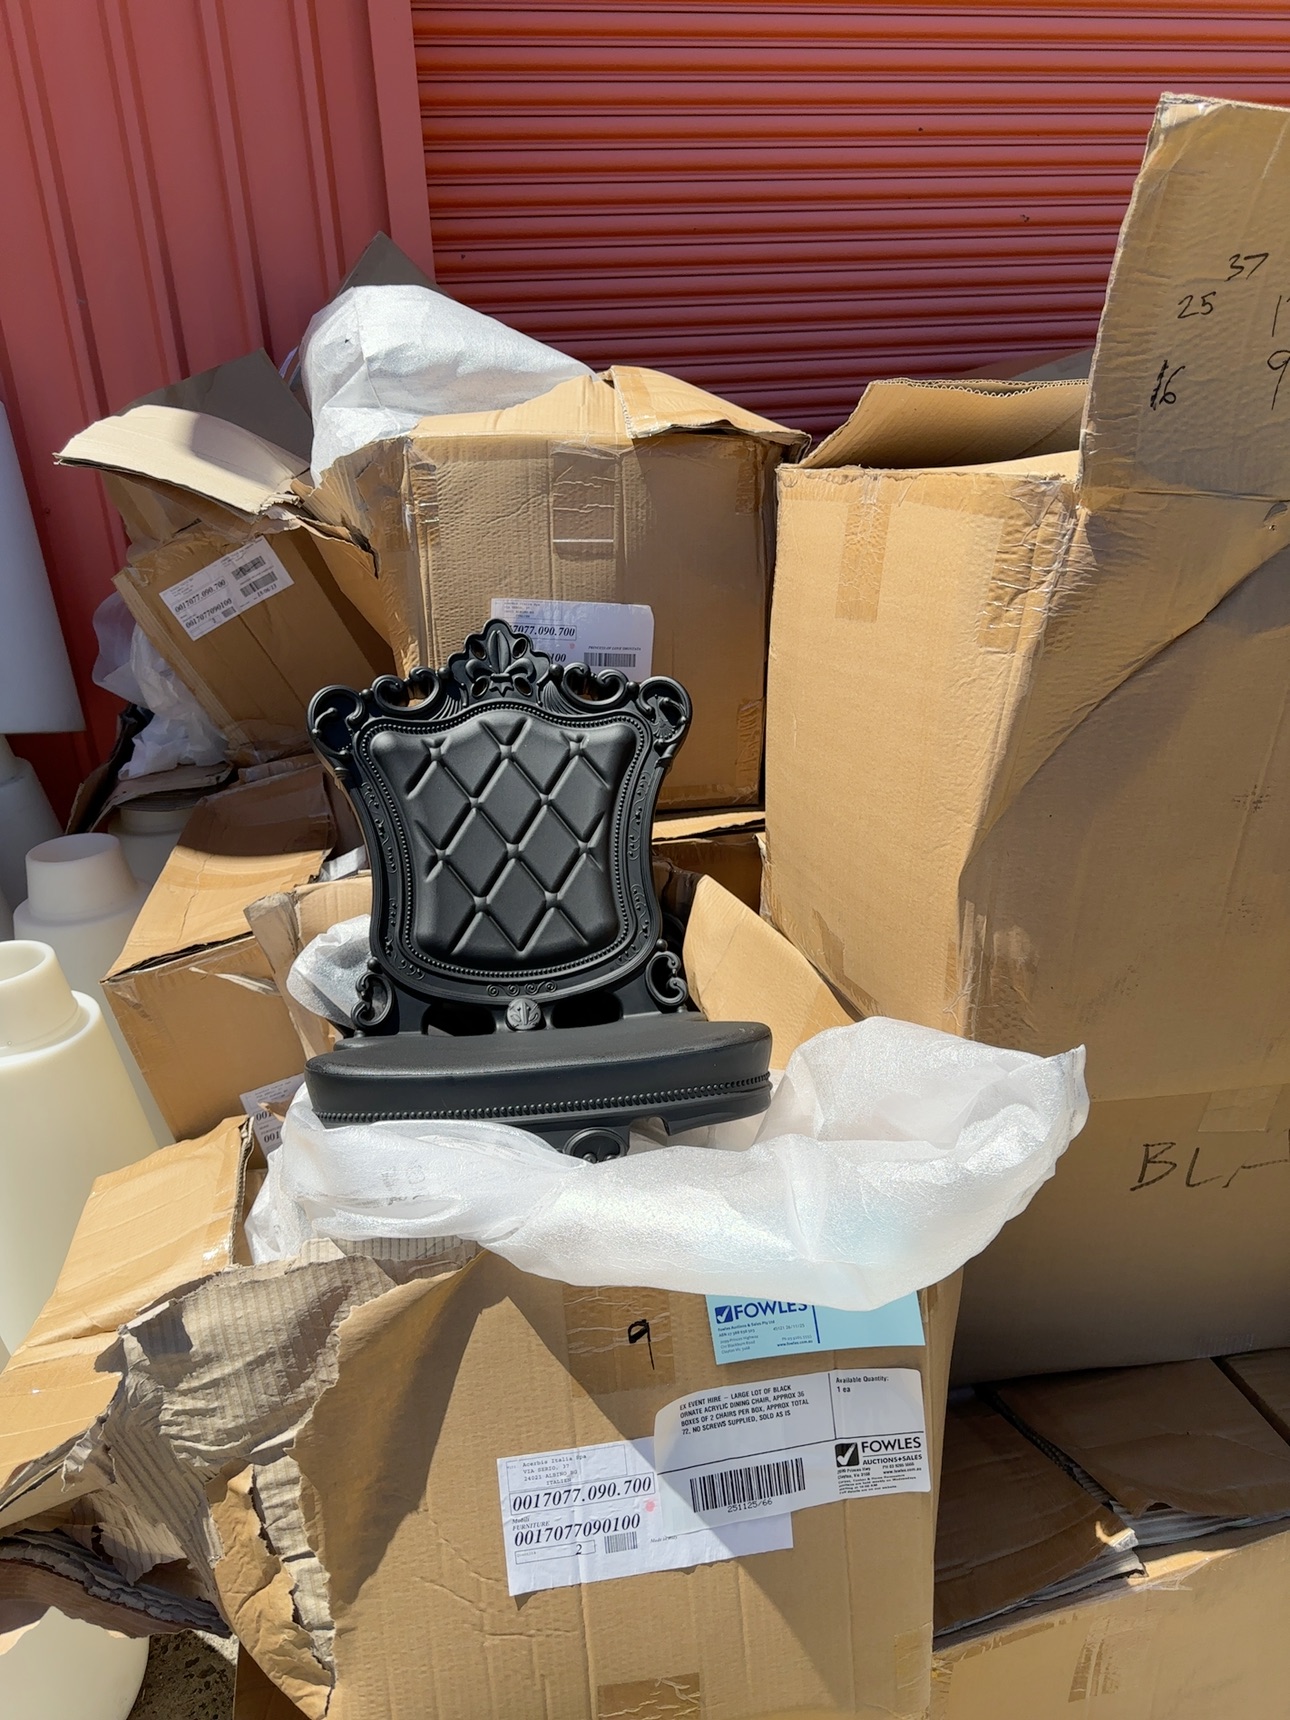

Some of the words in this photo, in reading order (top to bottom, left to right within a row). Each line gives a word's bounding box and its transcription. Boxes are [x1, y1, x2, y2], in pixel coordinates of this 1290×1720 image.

[1224, 253, 1269, 282] 37
[1178, 291, 1216, 319] 25
[1267, 350, 1290, 410] 9
[733, 1300, 808, 1320] FOWLES
[628, 1319, 655, 1370] 9
[680, 1408, 703, 1419] ORNATE
[704, 1404, 729, 1415] ACRYLIC
[730, 1399, 750, 1409] DINING
[751, 1395, 771, 1405] CHAIR,
[773, 1392, 796, 1402] APPROX
[688, 1399, 706, 1409] EVENT
[707, 1395, 721, 1404] HIRE
[730, 1391, 750, 1400] LARGE
[751, 1389, 762, 1397] LOT
[763, 1387, 771, 1395] OF
[773, 1385, 792, 1393] BLACK
[681, 1417, 700, 1427] BOXES
[700, 1415, 709, 1423] OF
[715, 1410, 737, 1420] CHAIRS
[738, 1407, 750, 1416] PER
[751, 1405, 765, 1414] BOX,
[766, 1402, 790, 1412] APPROX
[791, 1398, 809, 1408] TOTAL
[692, 1425, 701, 1433] NO
[702, 1421, 727, 1431] SCREWS
[728, 1415, 758, 1426] SUPPLIED,
[759, 1413, 775, 1422] SOLD
[785, 1409, 791, 1417] IS
[861, 1436, 922, 1453] FOWLES
[551, 1456, 573, 1464] Italia
[512, 1476, 652, 1512] 0017077.090.700
[727, 1498, 773, 1513] 251125/66
[512, 1520, 550, 1531] FURNITURE
[514, 1513, 641, 1547] 0017077090100
[575, 1543, 583, 1556] 2
